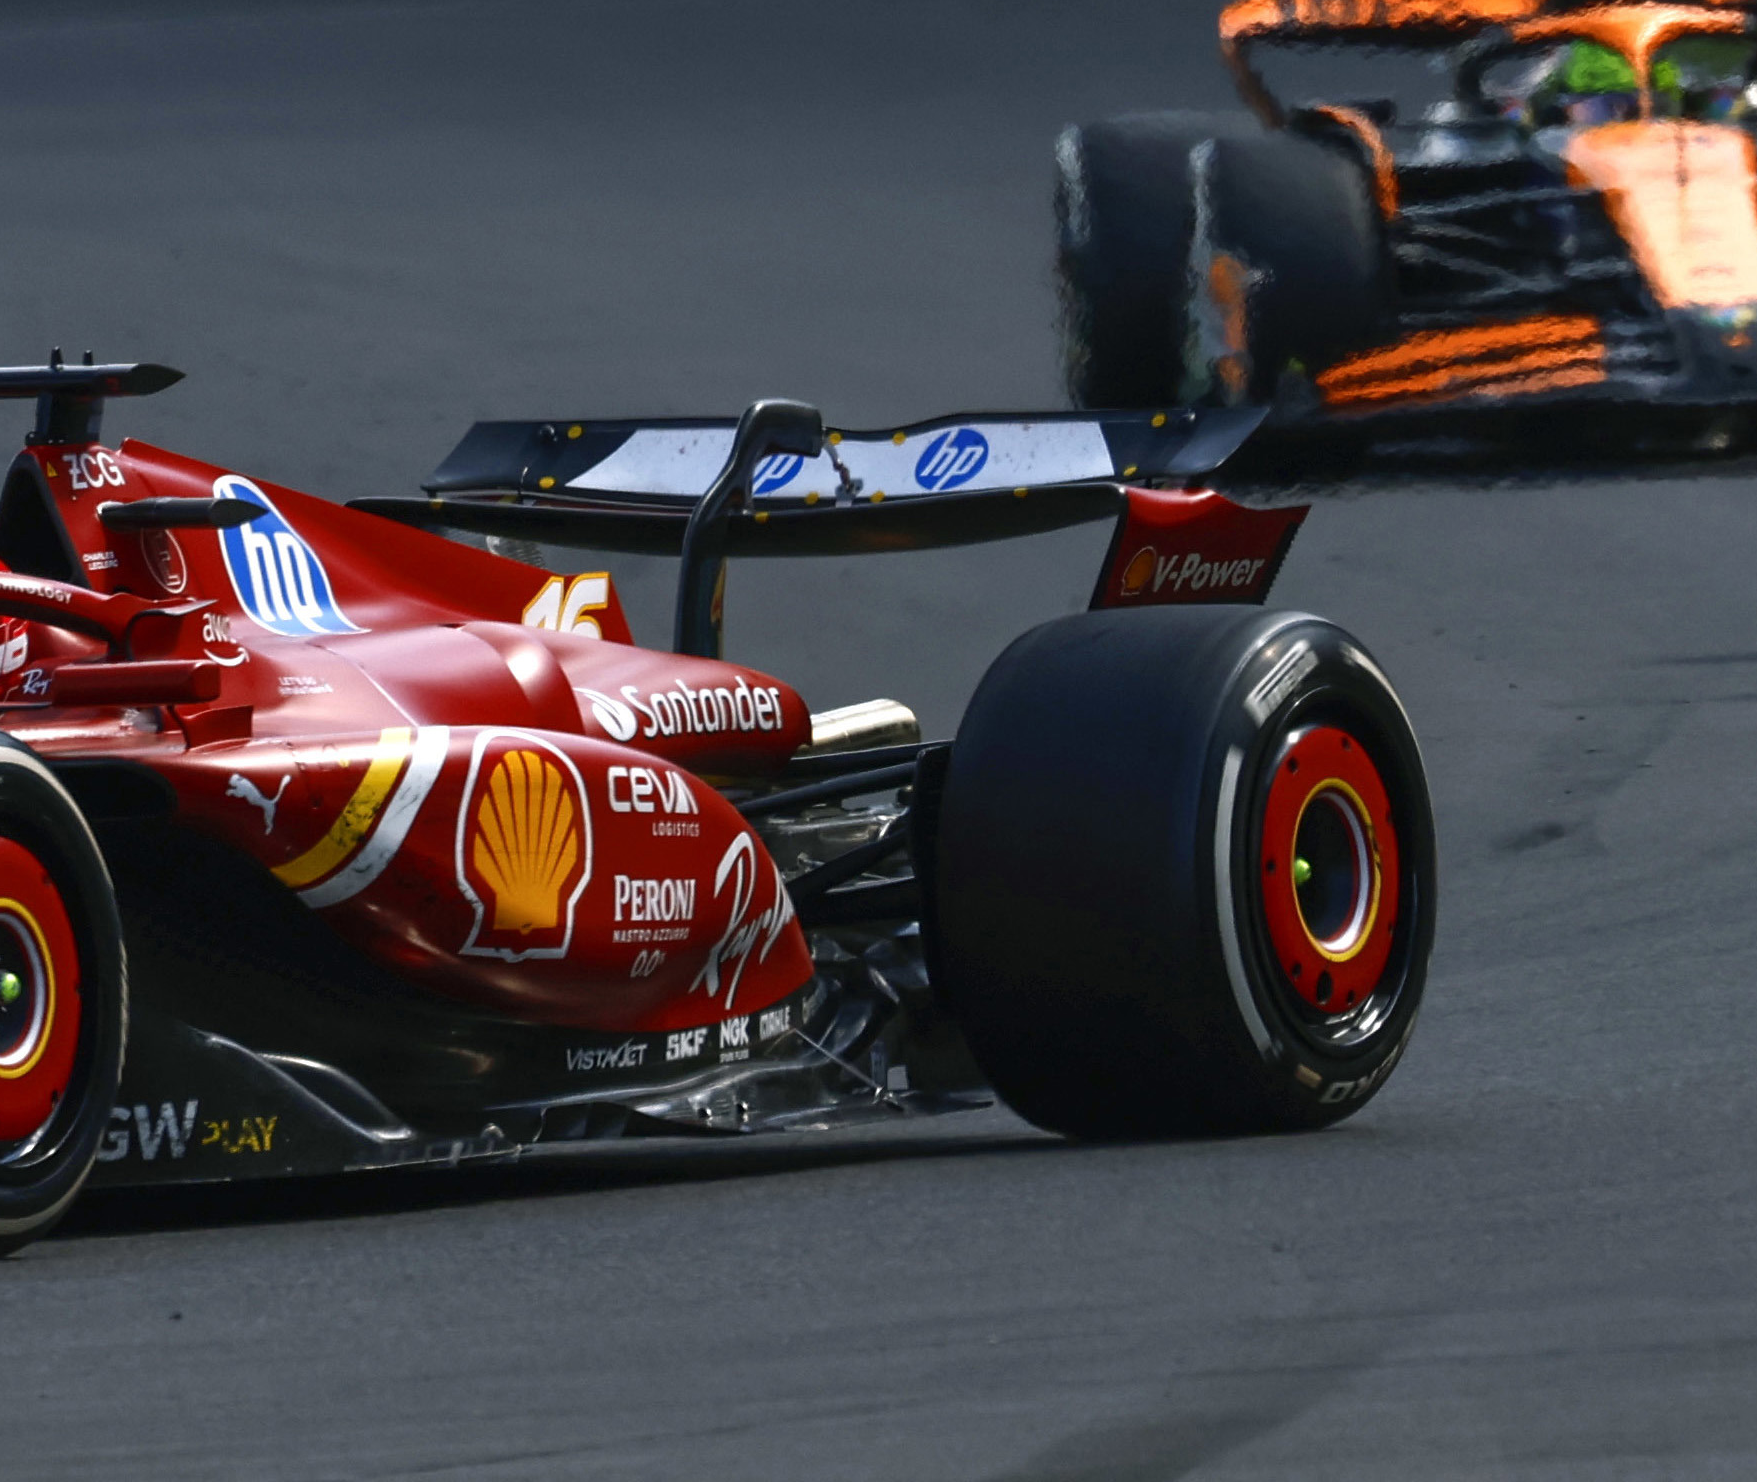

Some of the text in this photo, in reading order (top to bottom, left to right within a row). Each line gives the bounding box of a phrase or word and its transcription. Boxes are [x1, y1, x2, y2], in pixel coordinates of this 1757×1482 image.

[917, 427, 986, 491] hp
[1152, 553, 1265, 593] V-Power
[522, 571, 611, 639] 16
[620, 676, 783, 738] Santander
[652, 822, 700, 837] LOGISTICS
[614, 874, 696, 922] PERONI
[612, 929, 652, 943] NASTRO
[665, 1028, 709, 1061] SKF
[720, 1015, 750, 1048] NGK
